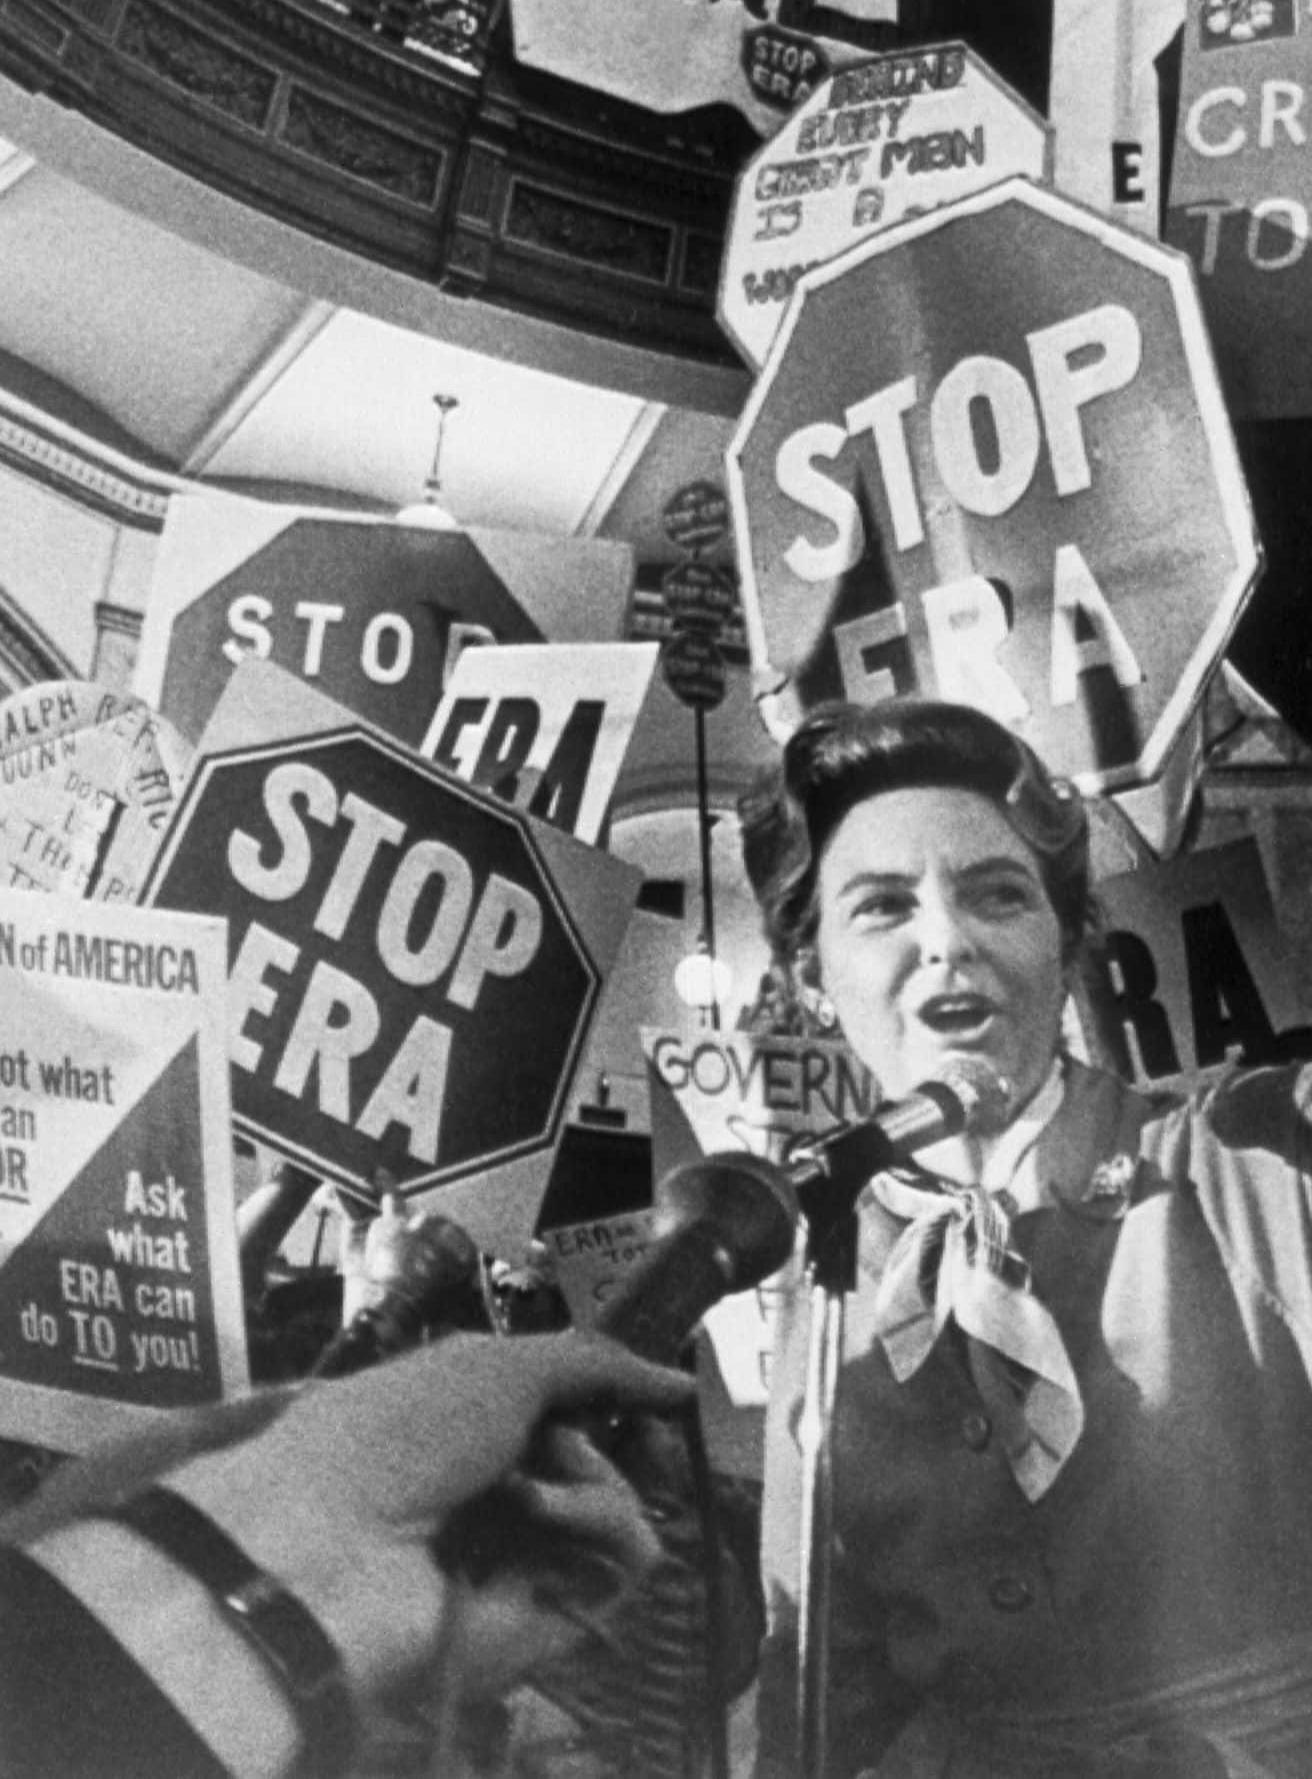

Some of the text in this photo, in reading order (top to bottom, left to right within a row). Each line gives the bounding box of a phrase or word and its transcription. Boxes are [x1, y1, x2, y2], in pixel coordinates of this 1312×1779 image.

[754, 35, 817, 74] STOP
[1184, 197, 1310, 276] TO
[775, 303, 1142, 582] STOP
[833, 543, 1144, 722] ERA
[4, 693, 78, 744] ALPH
[431, 697, 606, 834] ERA
[228, 762, 543, 1010] STOP
[20, 934, 48, 972] of
[53, 930, 200, 996] AMERICA
[1092, 899, 1285, 1084] RA
[228, 921, 453, 1165] ERA
[0, 1049, 115, 1106] ot what
[0, 1105, 36, 1141] an
[125, 1170, 188, 1223] Ask
[107, 1223, 192, 1273] what
[60, 1259, 196, 1322] ERA can
[20, 1302, 199, 1373] do TO you!
